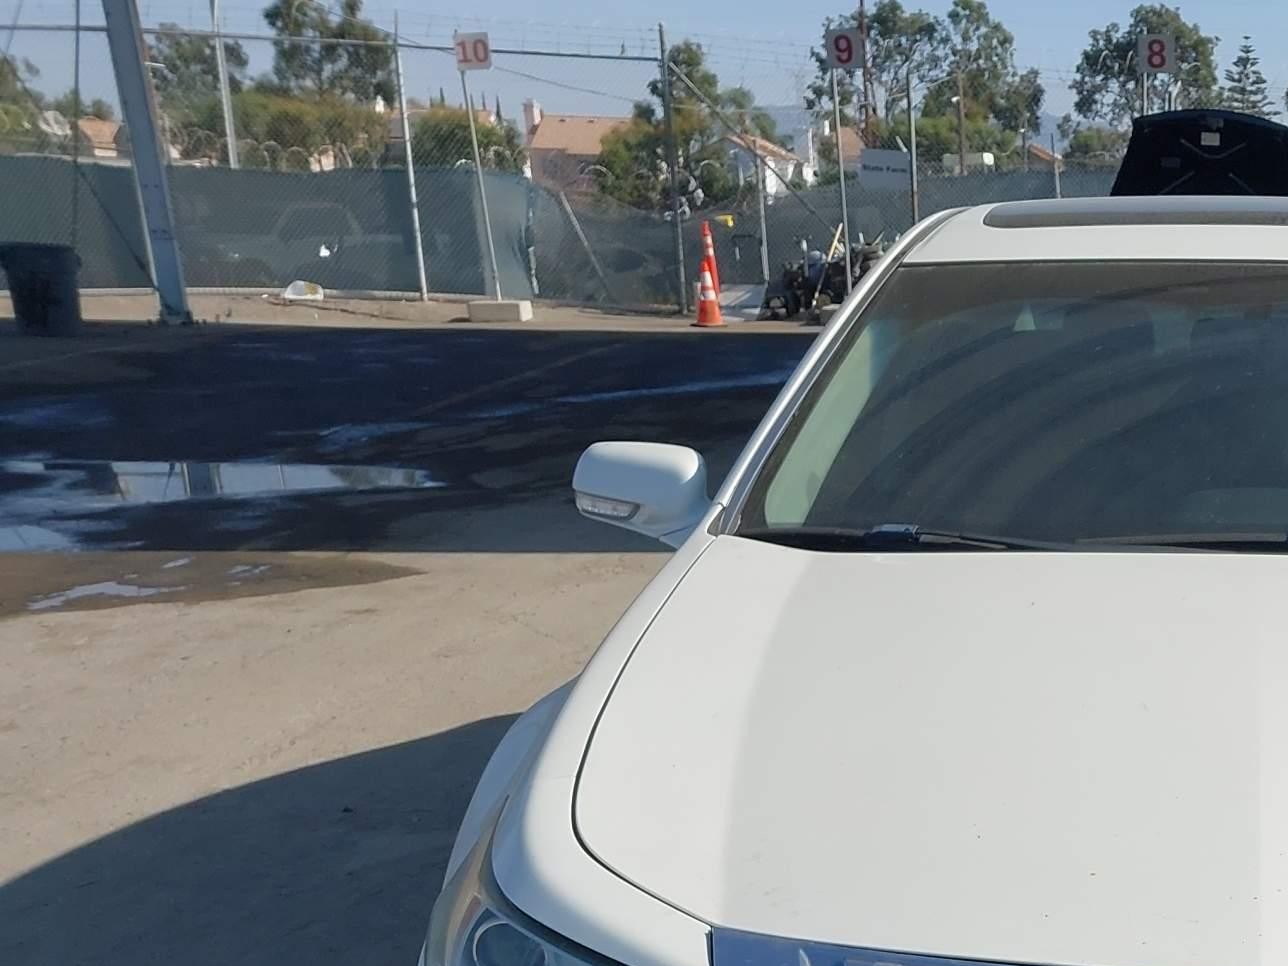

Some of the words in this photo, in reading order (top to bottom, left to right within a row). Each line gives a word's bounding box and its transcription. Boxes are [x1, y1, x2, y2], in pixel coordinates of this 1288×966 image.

[455, 39, 489, 64] 10
[833, 34, 853, 64] 9
[1147, 38, 1166, 69] 8
